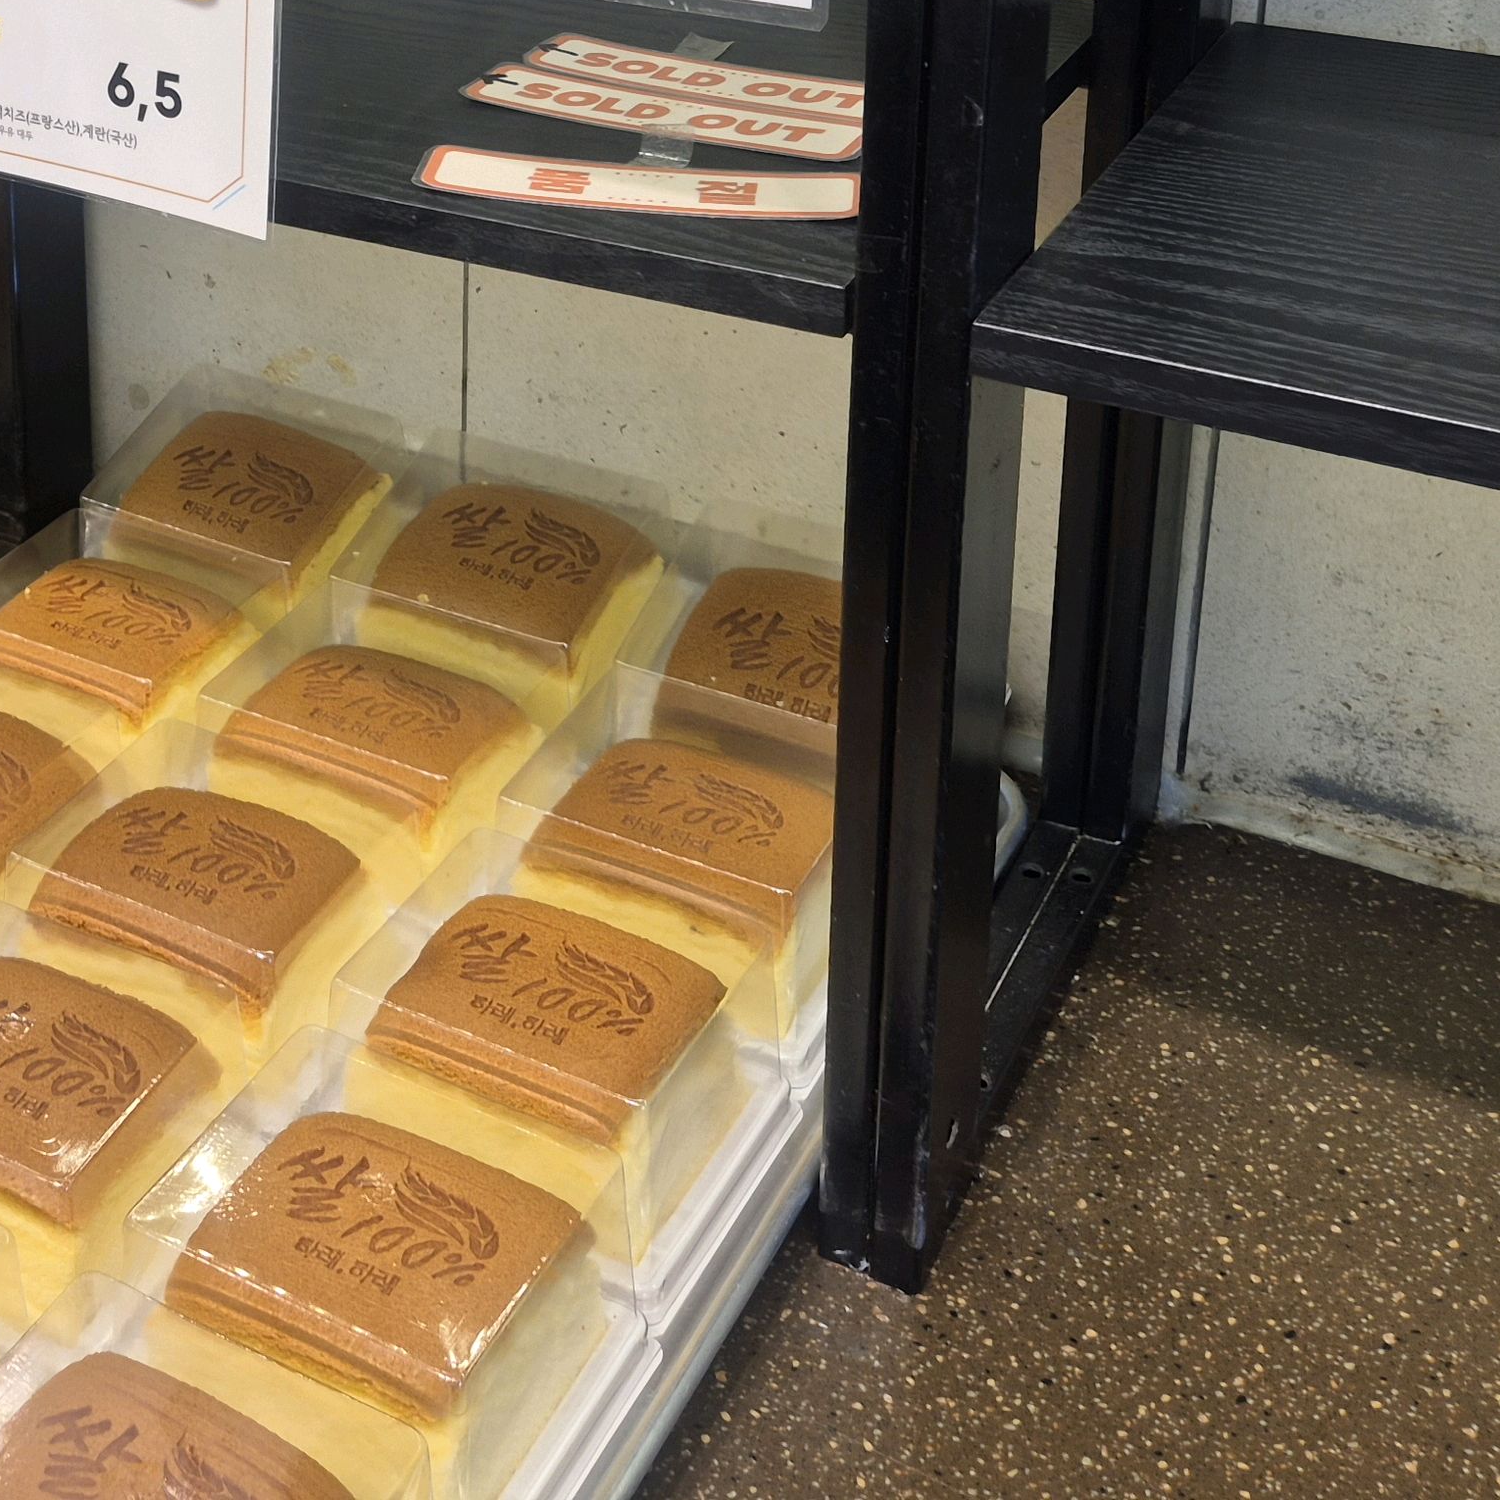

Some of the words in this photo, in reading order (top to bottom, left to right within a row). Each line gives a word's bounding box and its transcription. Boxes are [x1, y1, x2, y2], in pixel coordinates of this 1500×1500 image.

[107, 62, 183, 122] 6,5
[514, 82, 671, 120] SOLD
[687, 114, 827, 144] OUT
[574, 51, 727, 88] SOLD
[742, 81, 864, 110] OUT
[174, 445, 236, 490] 쌀
[212, 481, 303, 524] 100%
[443, 502, 511, 548] 쌀
[491, 539, 591, 584] 100%
[713, 607, 792, 671] 쌀
[168, 847, 284, 900] 100%
[450, 923, 537, 983] 쌀
[512, 977, 645, 1035] 100%
[0, 1047, 128, 1118] 100%
[341, 1213, 486, 1288] 100%
